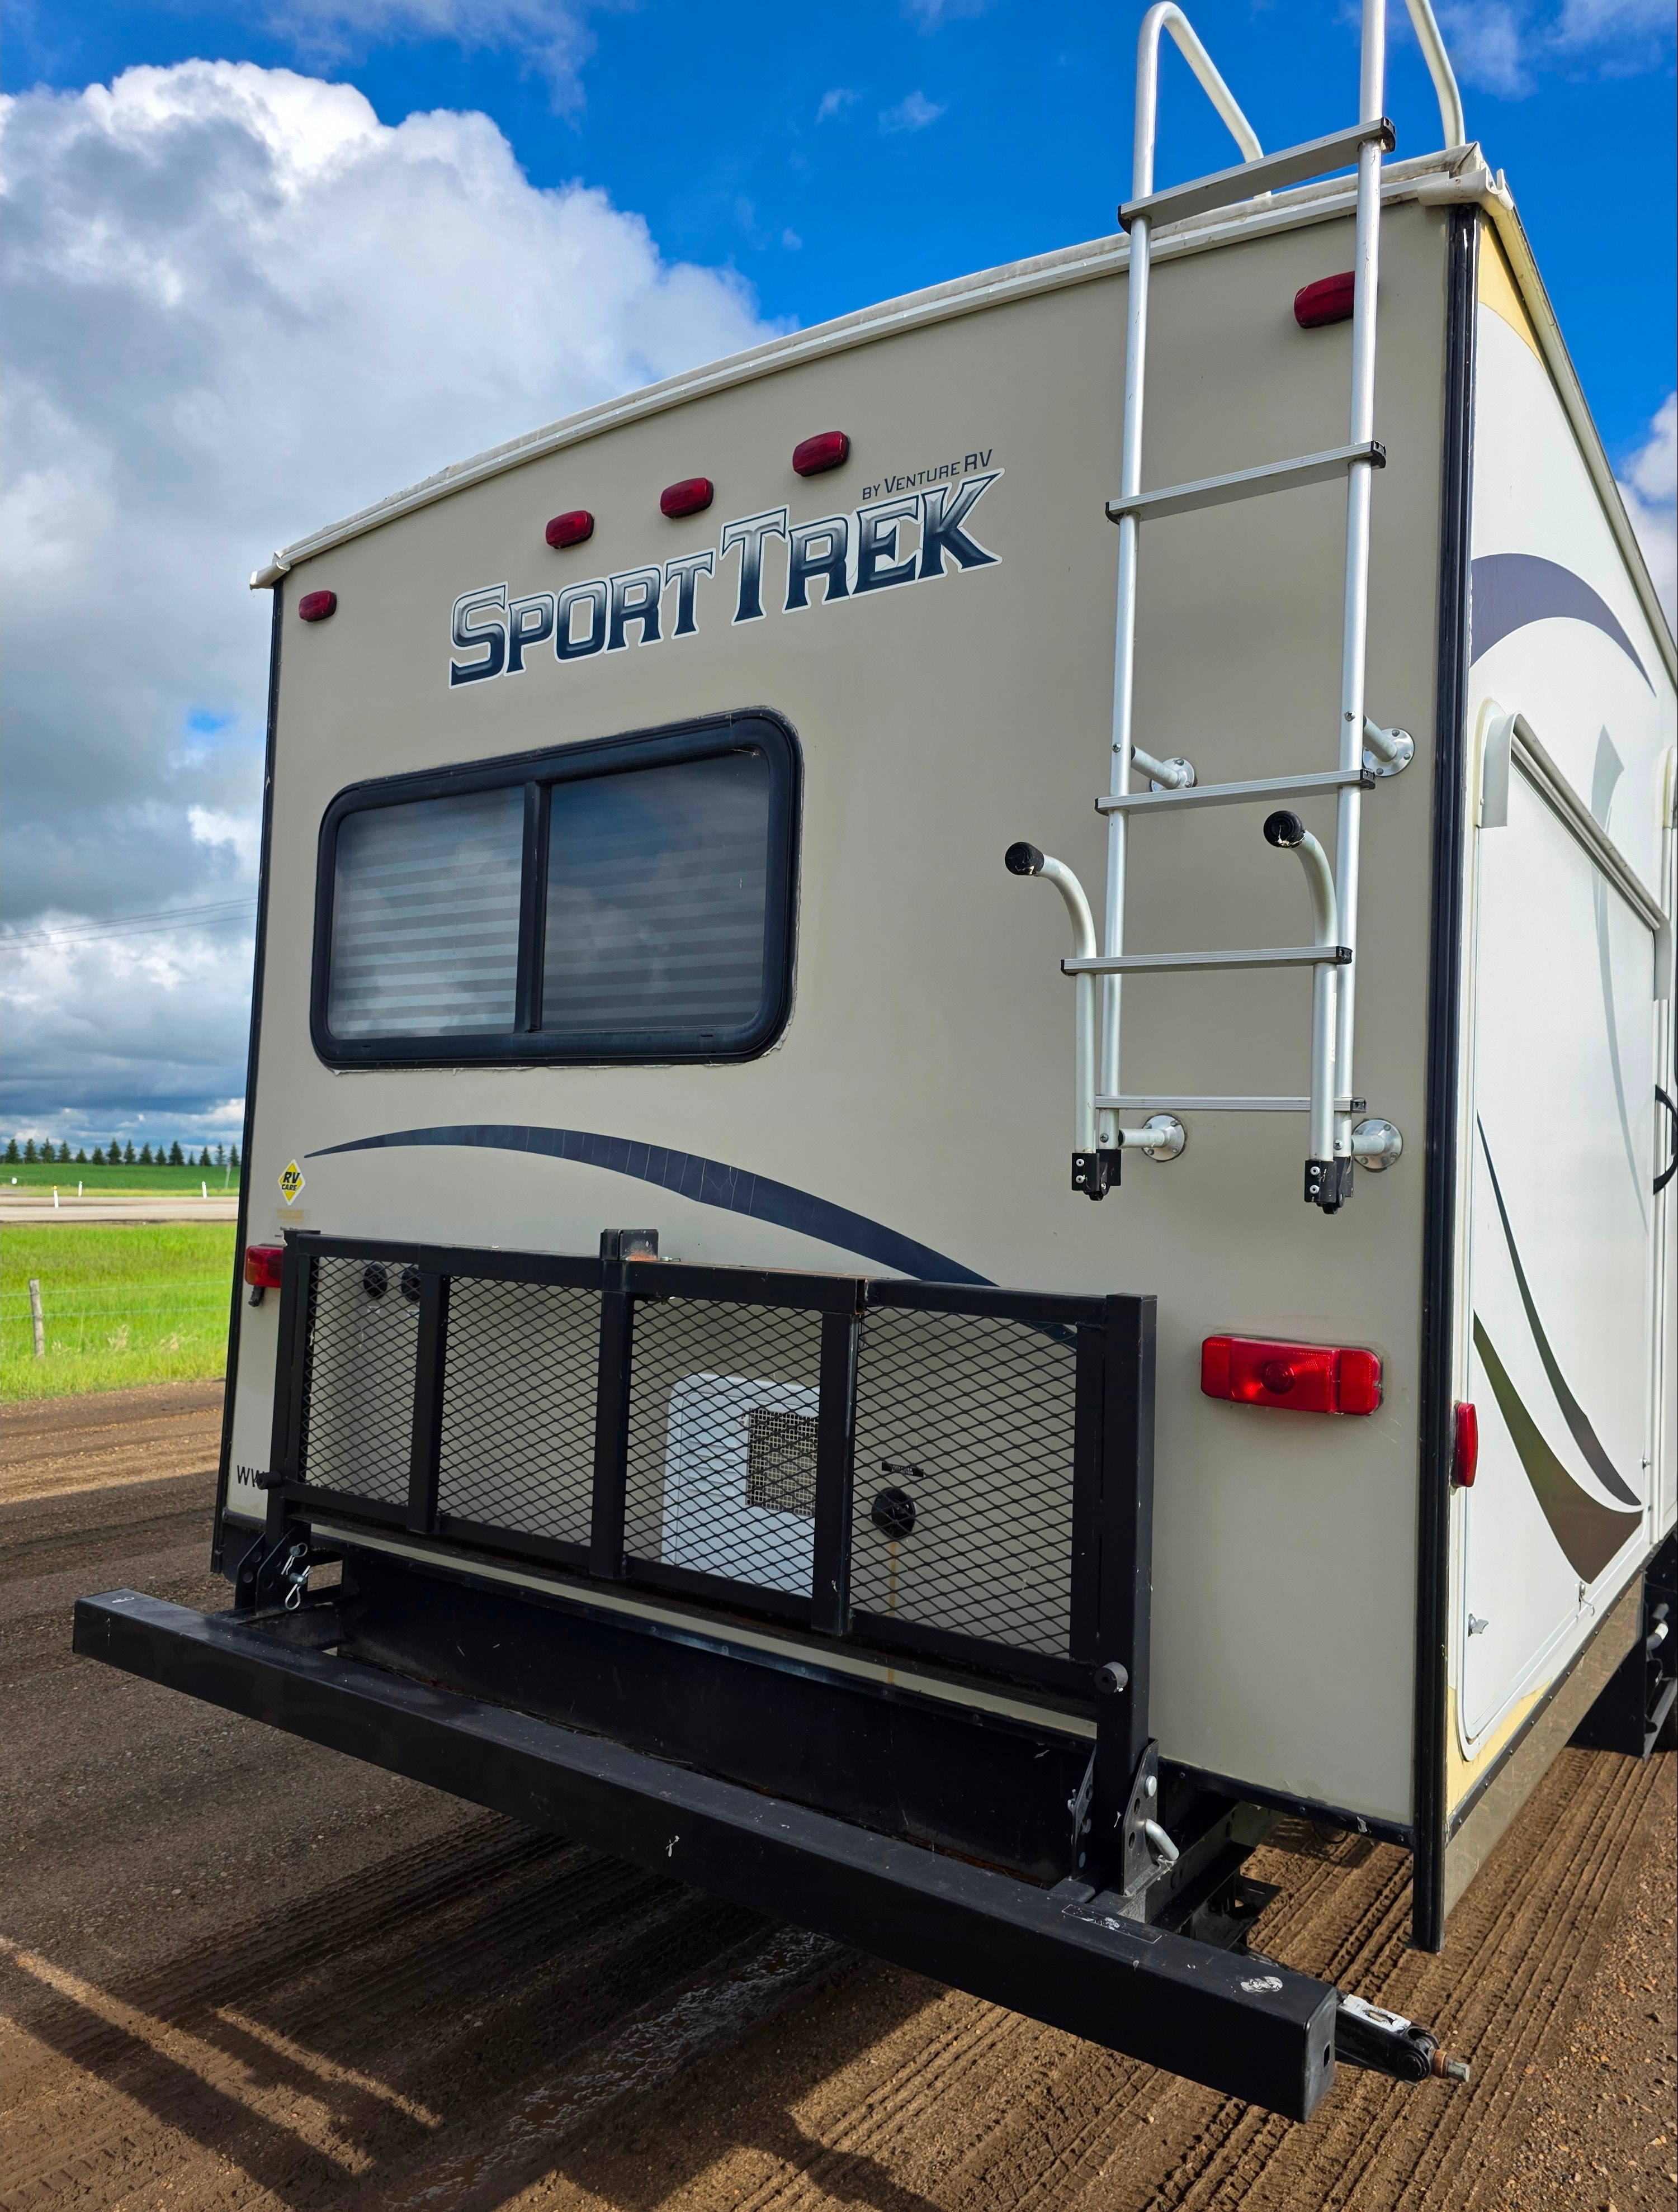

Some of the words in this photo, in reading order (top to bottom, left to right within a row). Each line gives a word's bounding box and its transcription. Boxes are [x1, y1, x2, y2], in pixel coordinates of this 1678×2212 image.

[863, 484, 881, 500] BY
[884, 462, 961, 494] VENTURE
[964, 449, 992, 472] RV
[282, 1171, 301, 1183] RV
